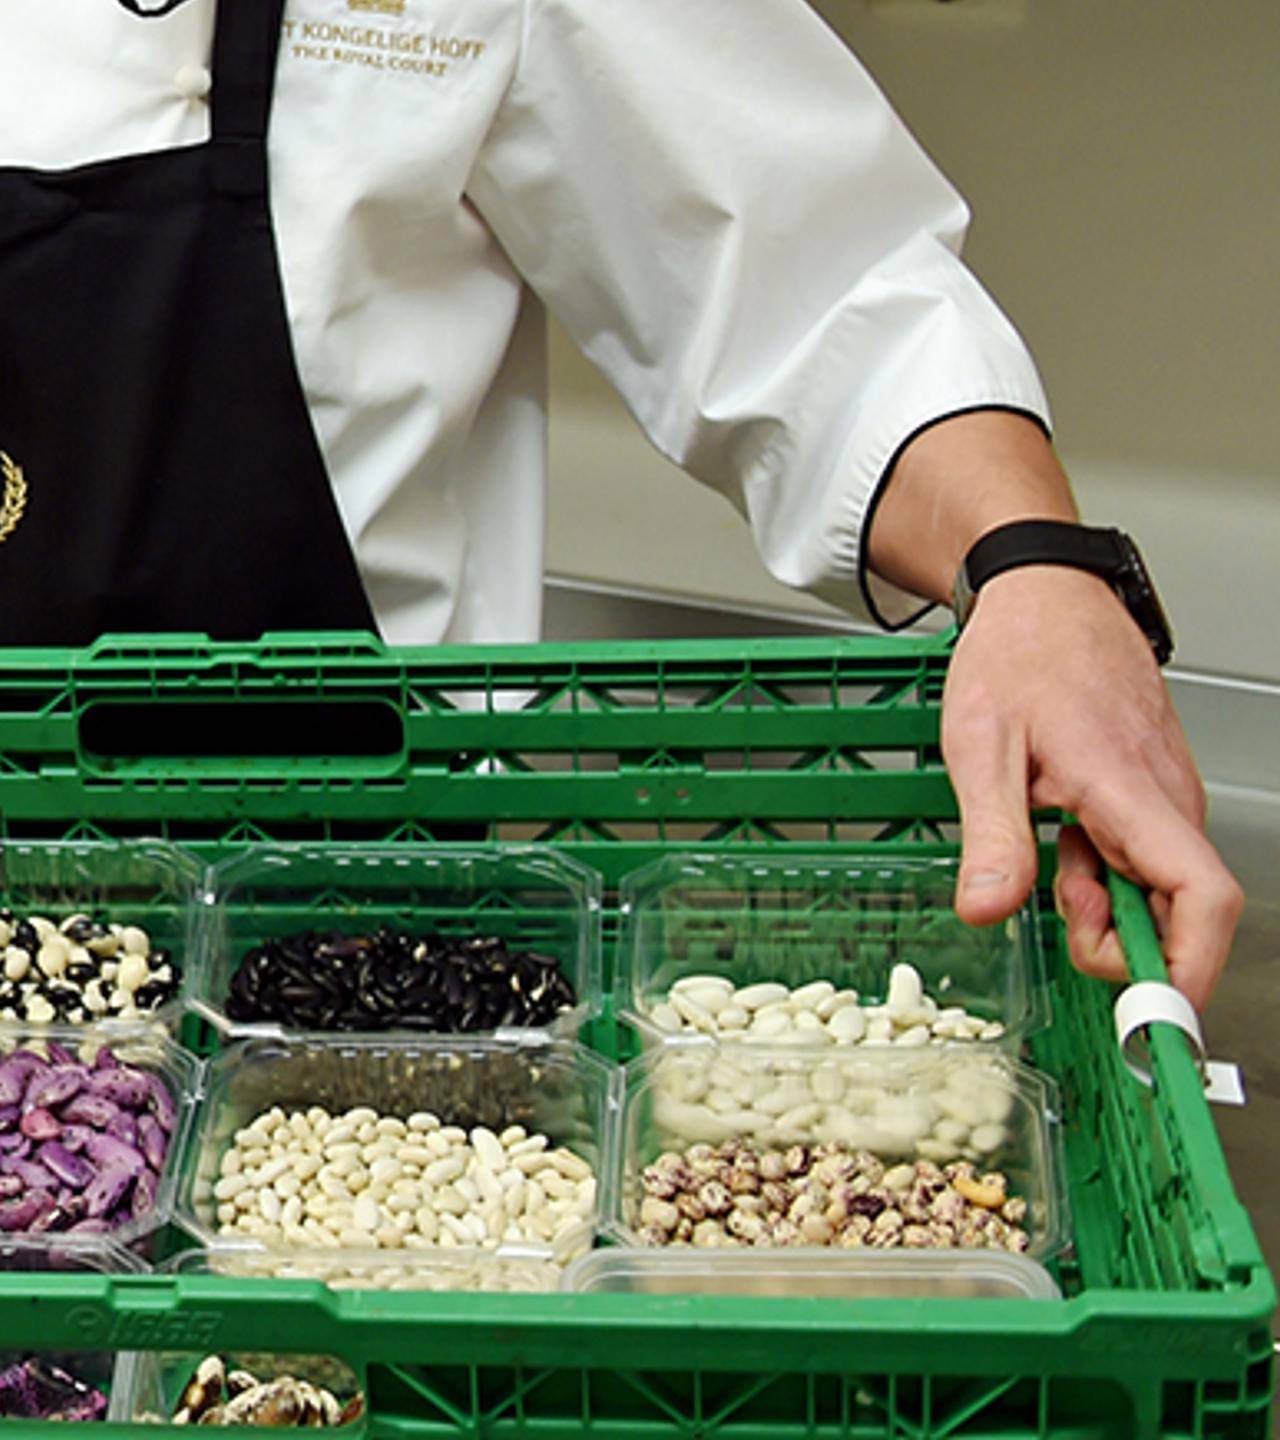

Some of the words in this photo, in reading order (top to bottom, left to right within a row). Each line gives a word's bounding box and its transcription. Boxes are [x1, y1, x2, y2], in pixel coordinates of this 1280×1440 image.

[303, 21, 426, 55] KONGELIGE
[430, 35, 487, 60] HOFF
[291, 45, 328, 60] THE
[333, 47, 384, 70] ROYAL
[389, 56, 449, 77] COURT
